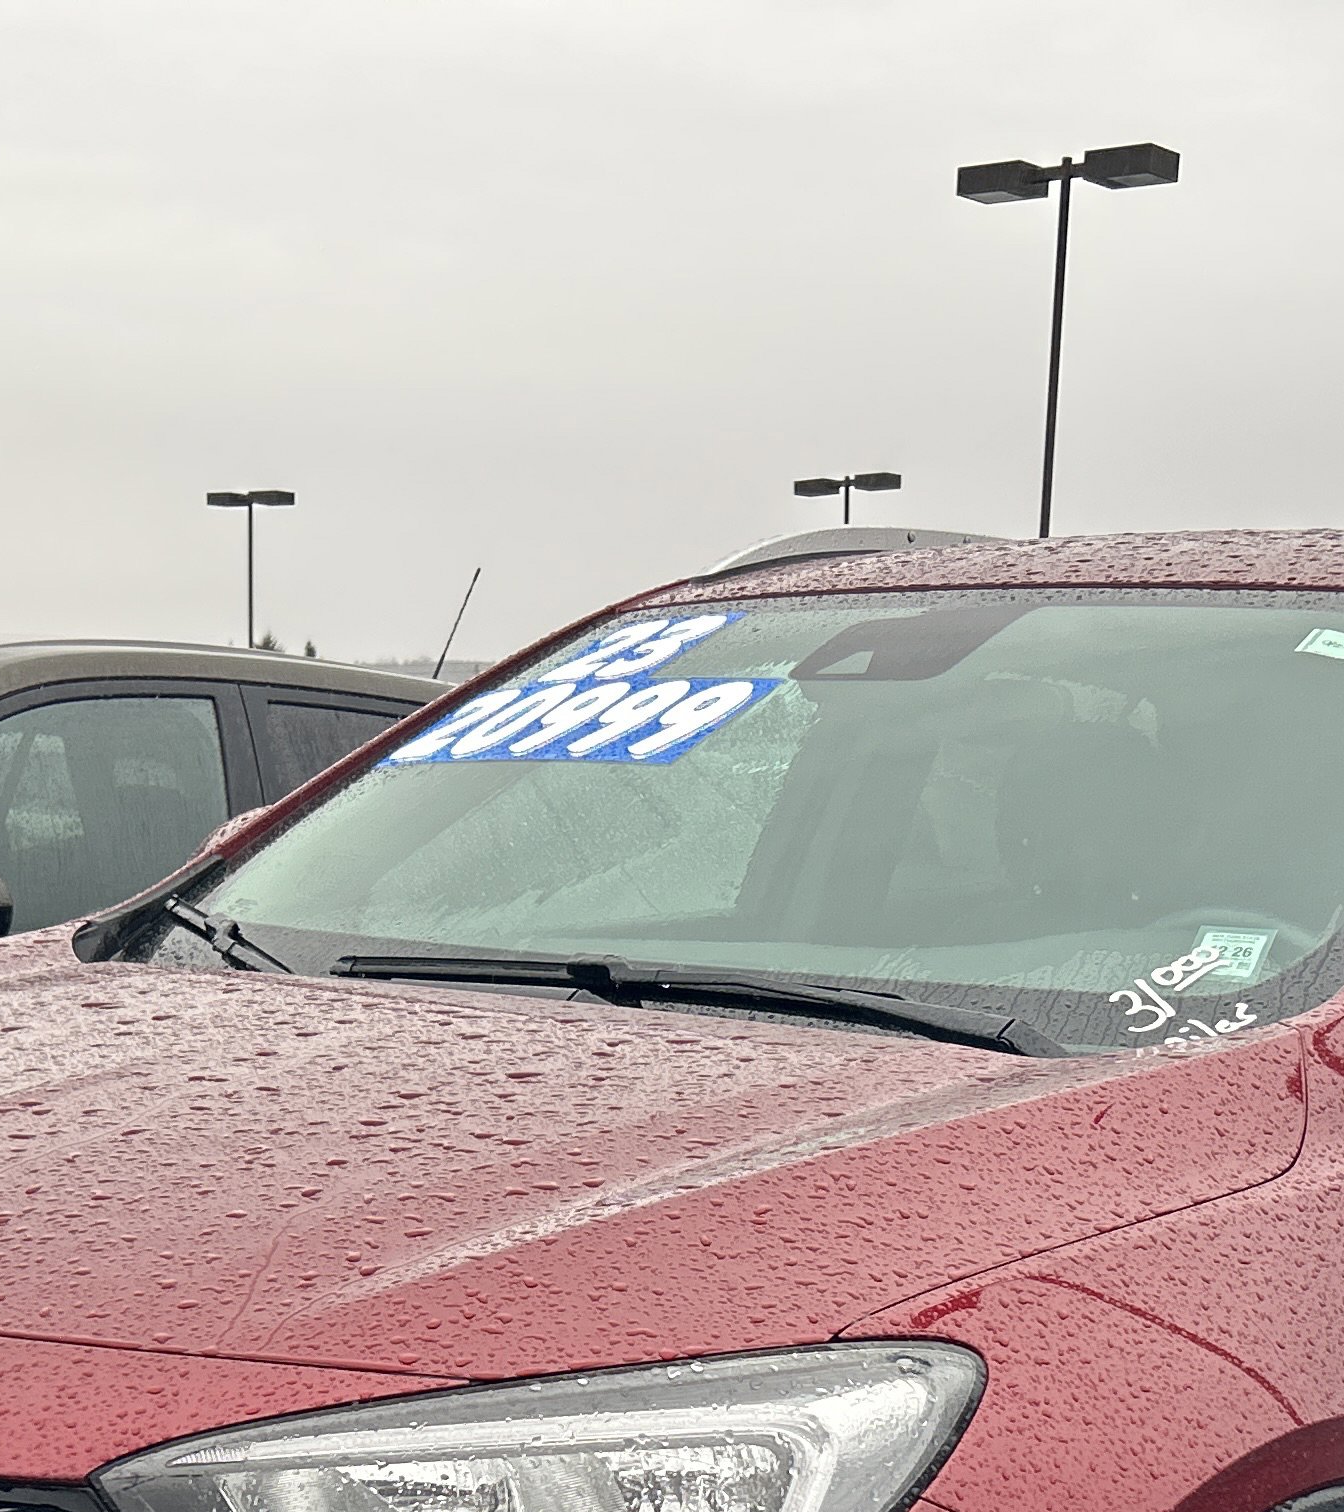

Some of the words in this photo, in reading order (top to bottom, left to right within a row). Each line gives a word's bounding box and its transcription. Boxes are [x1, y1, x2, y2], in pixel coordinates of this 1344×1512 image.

[537, 615, 728, 682] 23
[389, 681, 755, 760] 20999
[1232, 946, 1254, 958] 26
